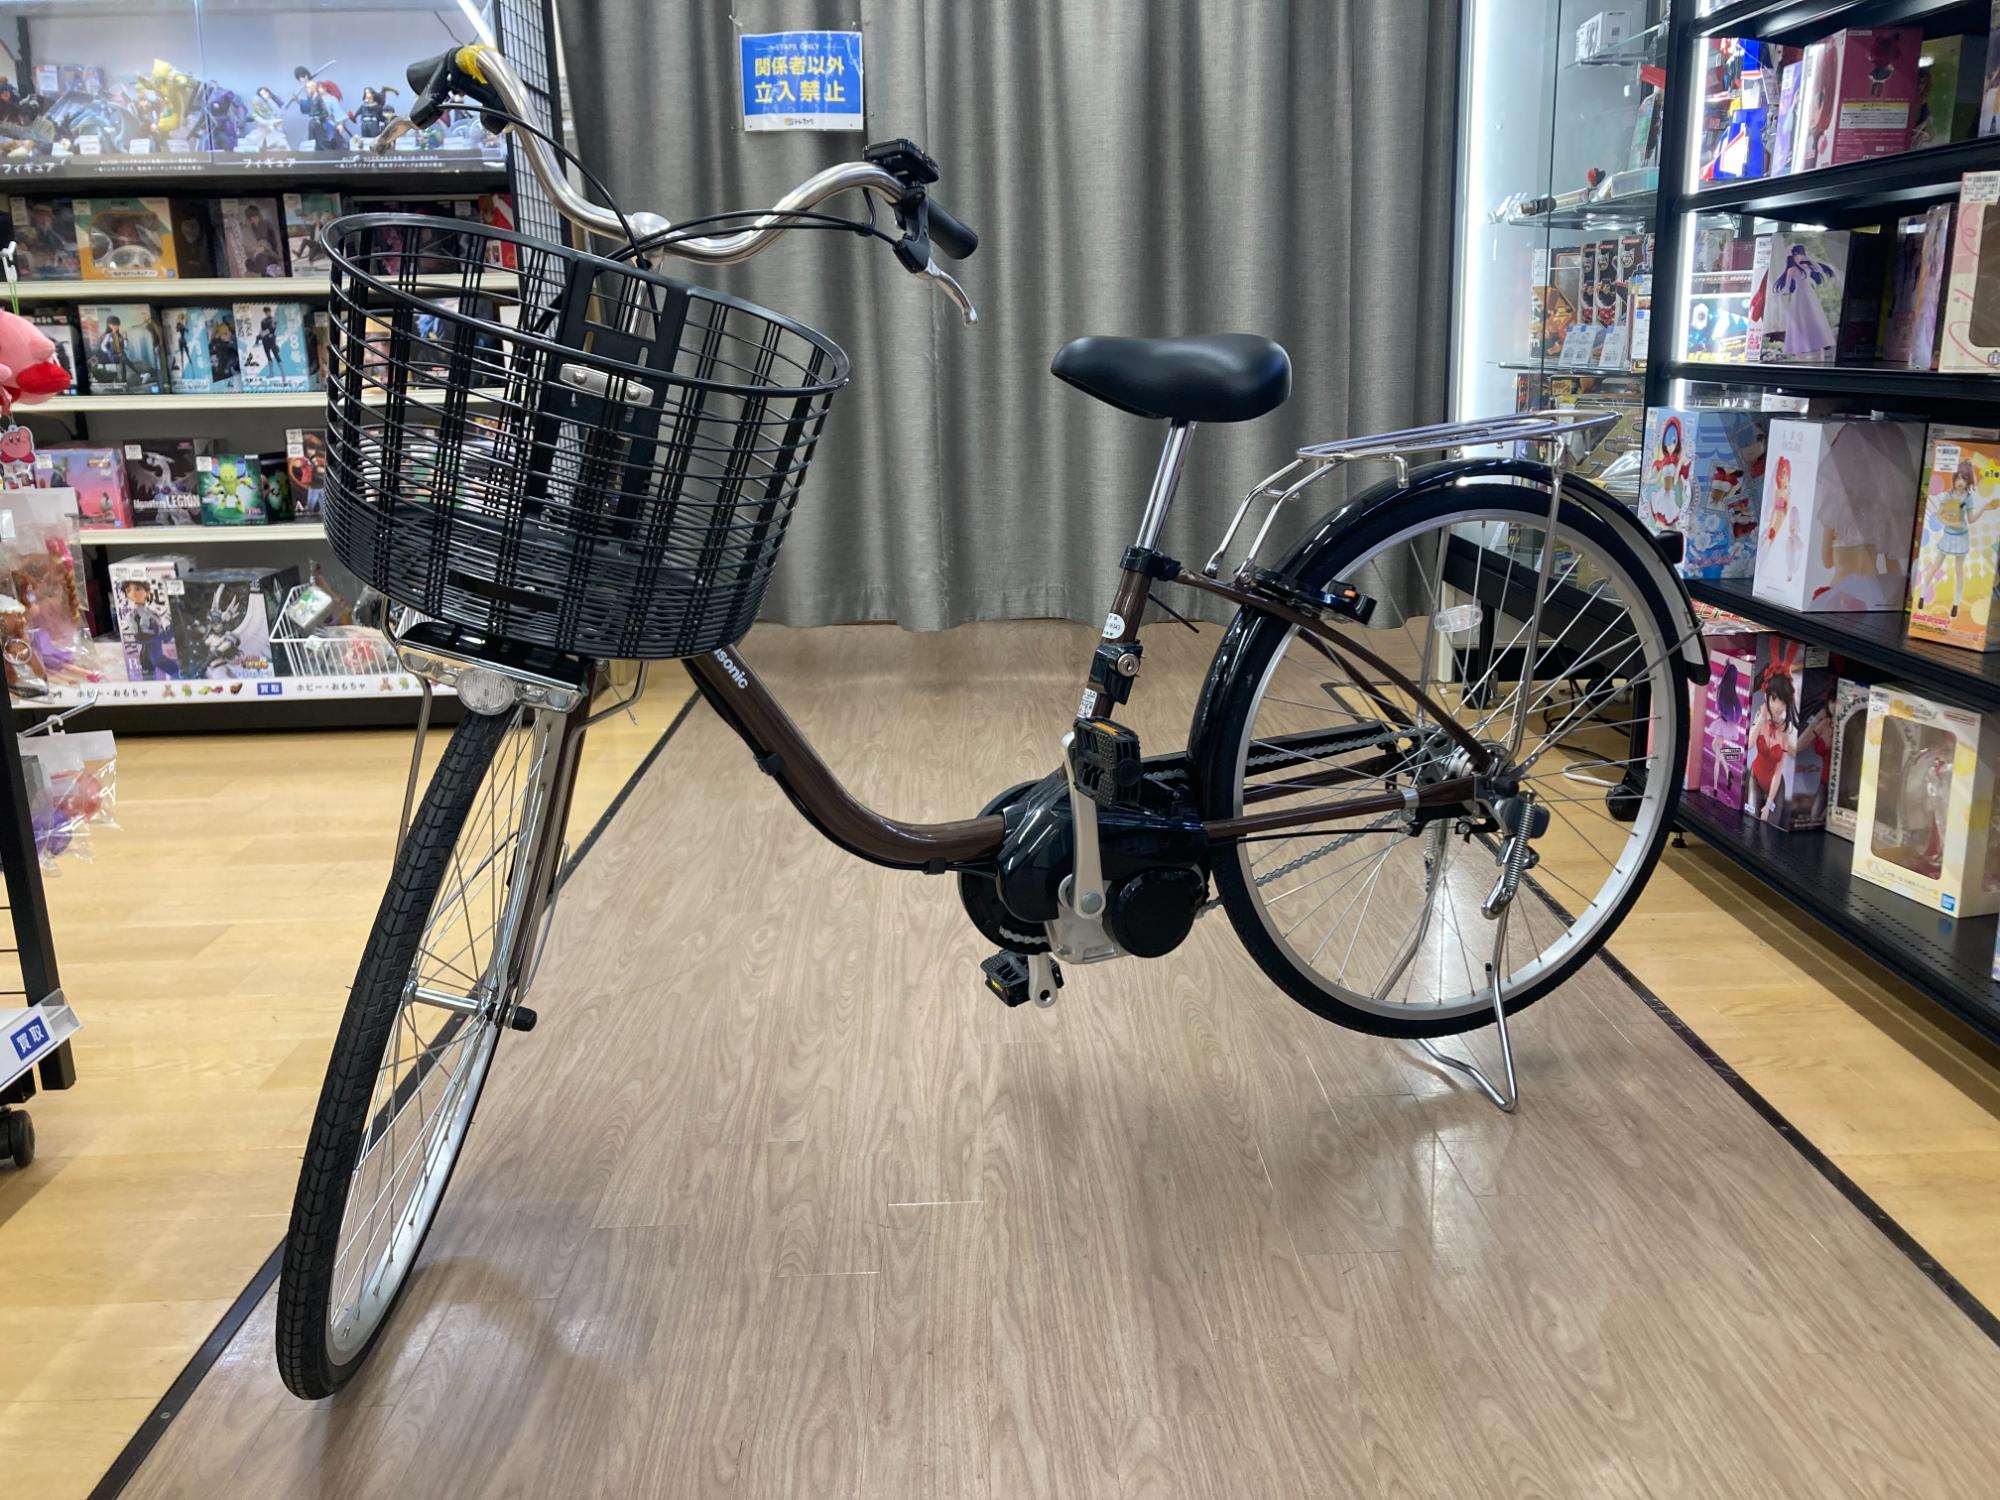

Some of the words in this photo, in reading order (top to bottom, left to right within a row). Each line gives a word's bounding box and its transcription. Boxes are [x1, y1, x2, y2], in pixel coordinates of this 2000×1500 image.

[754, 55, 845, 77] 関係者以外
[755, 79, 846, 104] 立入禁止
[2, 162, 56, 174] フィギュア
[242, 157, 297, 169] フィギュア
[166, 494, 201, 509] LEGION
[713, 648, 749, 689] sonic
[259, 683, 281, 695] 買取
[296, 681, 367, 692] ホビー・おもちゃ
[16, 1024, 45, 1054] 買取
